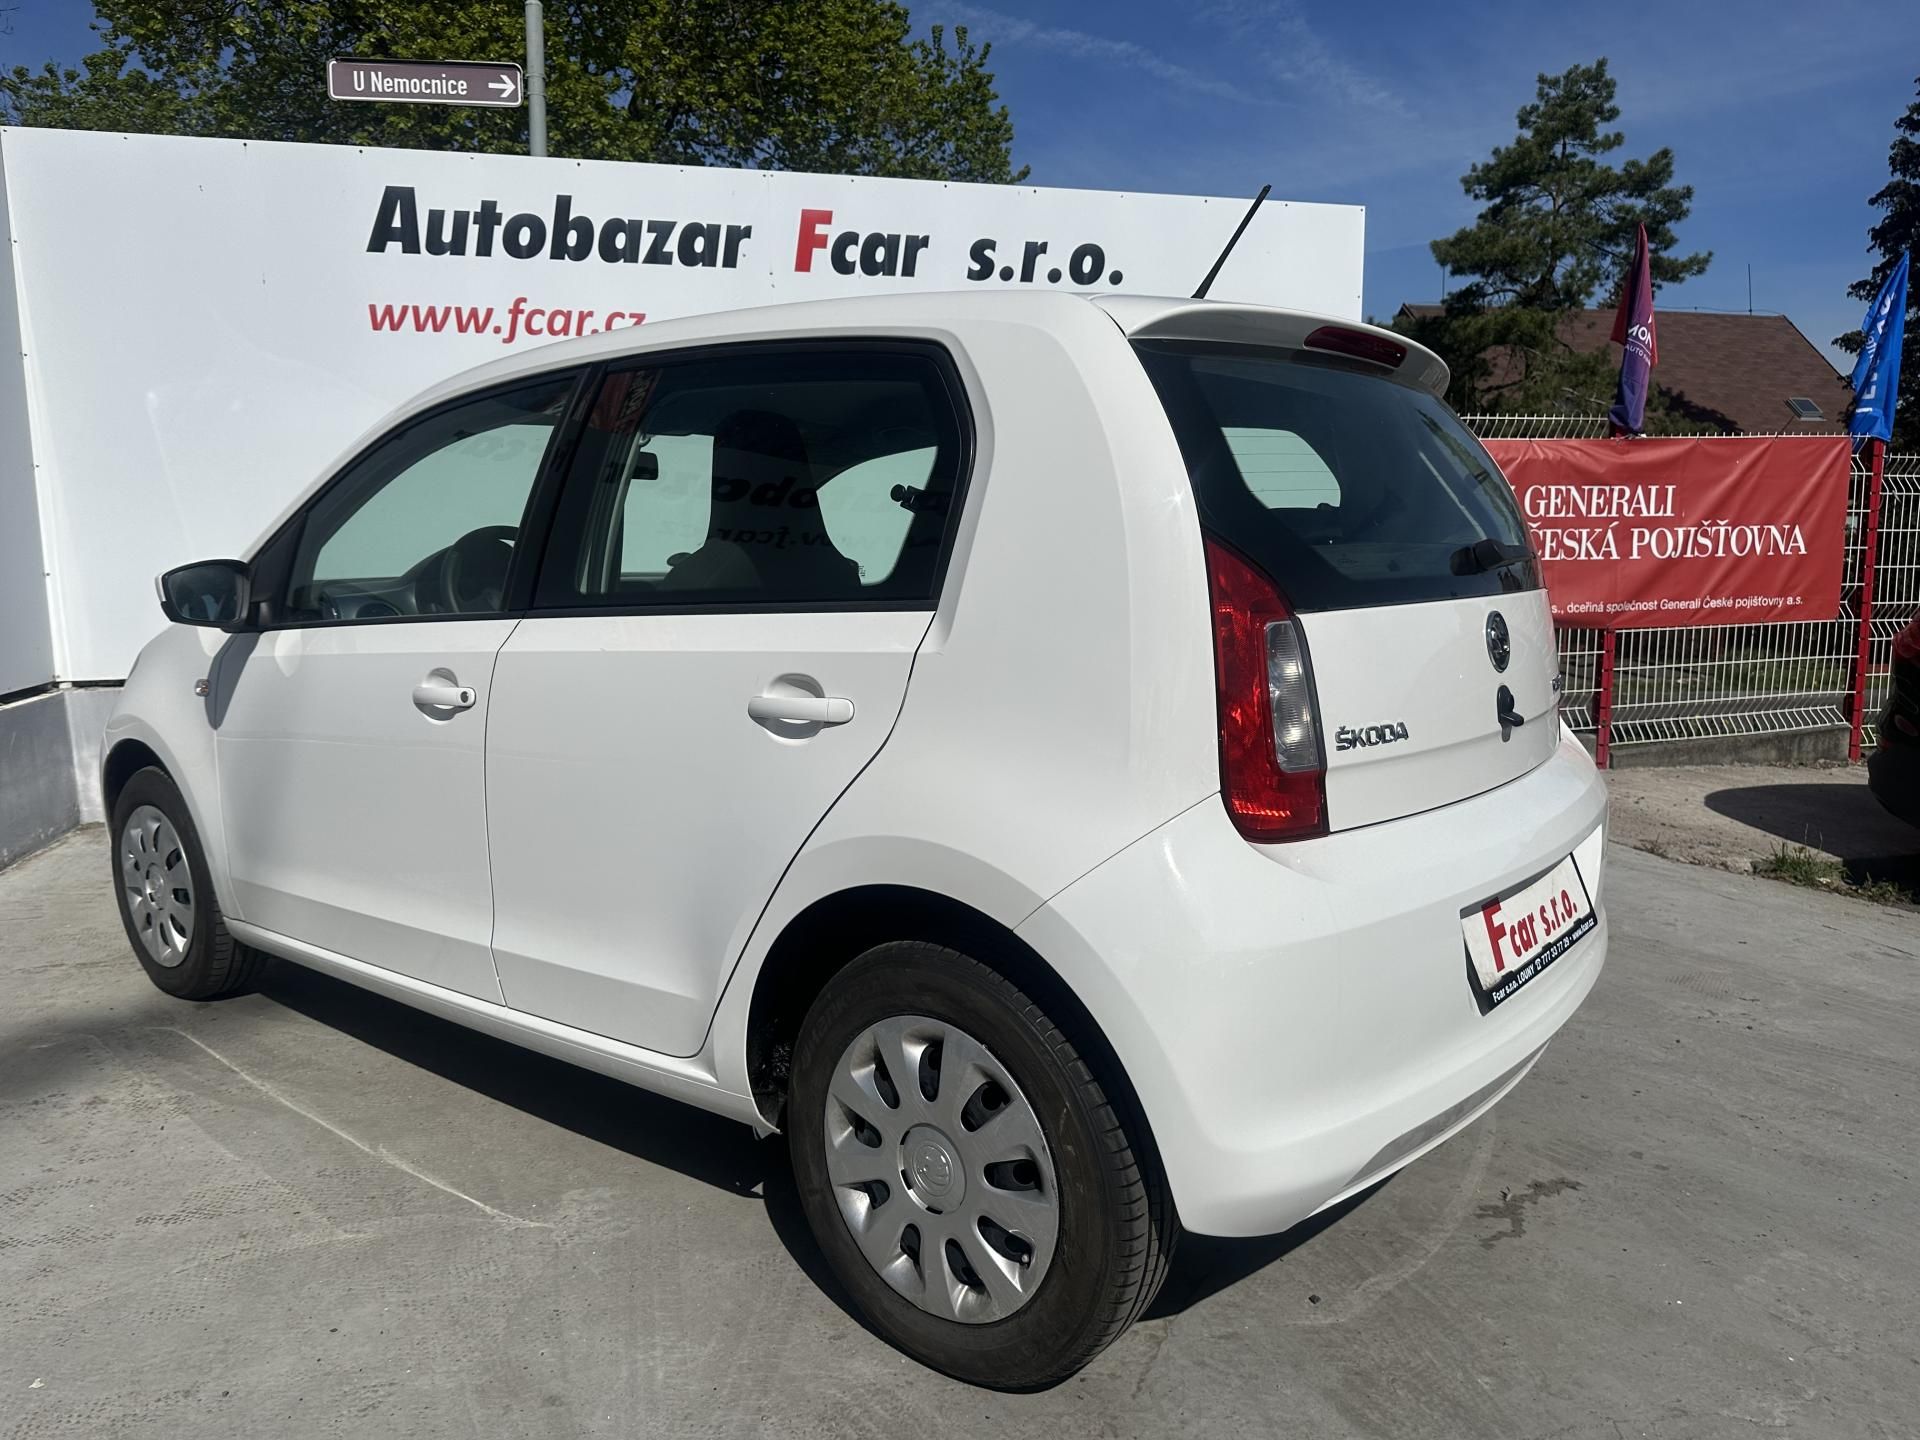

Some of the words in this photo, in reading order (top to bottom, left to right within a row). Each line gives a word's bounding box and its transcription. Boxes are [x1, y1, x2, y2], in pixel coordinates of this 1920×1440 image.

[353, 70, 365, 92] U
[371, 71, 468, 96] Nemocnice
[366, 185, 752, 269] Autobazar
[794, 208, 930, 278] Fcar
[966, 237, 1124, 286] s.r.o.
[1524, 484, 1676, 518] GENERALI
[1629, 519, 1807, 560] POJIŠŤOVNA
[1567, 601, 1604, 613] dceřiná
[1606, 600, 1658, 614] společnost
[1660, 598, 1701, 610] Generali
[1702, 595, 1734, 609] České
[1735, 595, 1785, 609] pojišťovny
[1335, 721, 1410, 751] ŠKODA
[1481, 897, 1539, 973] Fcar
[1539, 889, 1578, 937] s.r.o.
